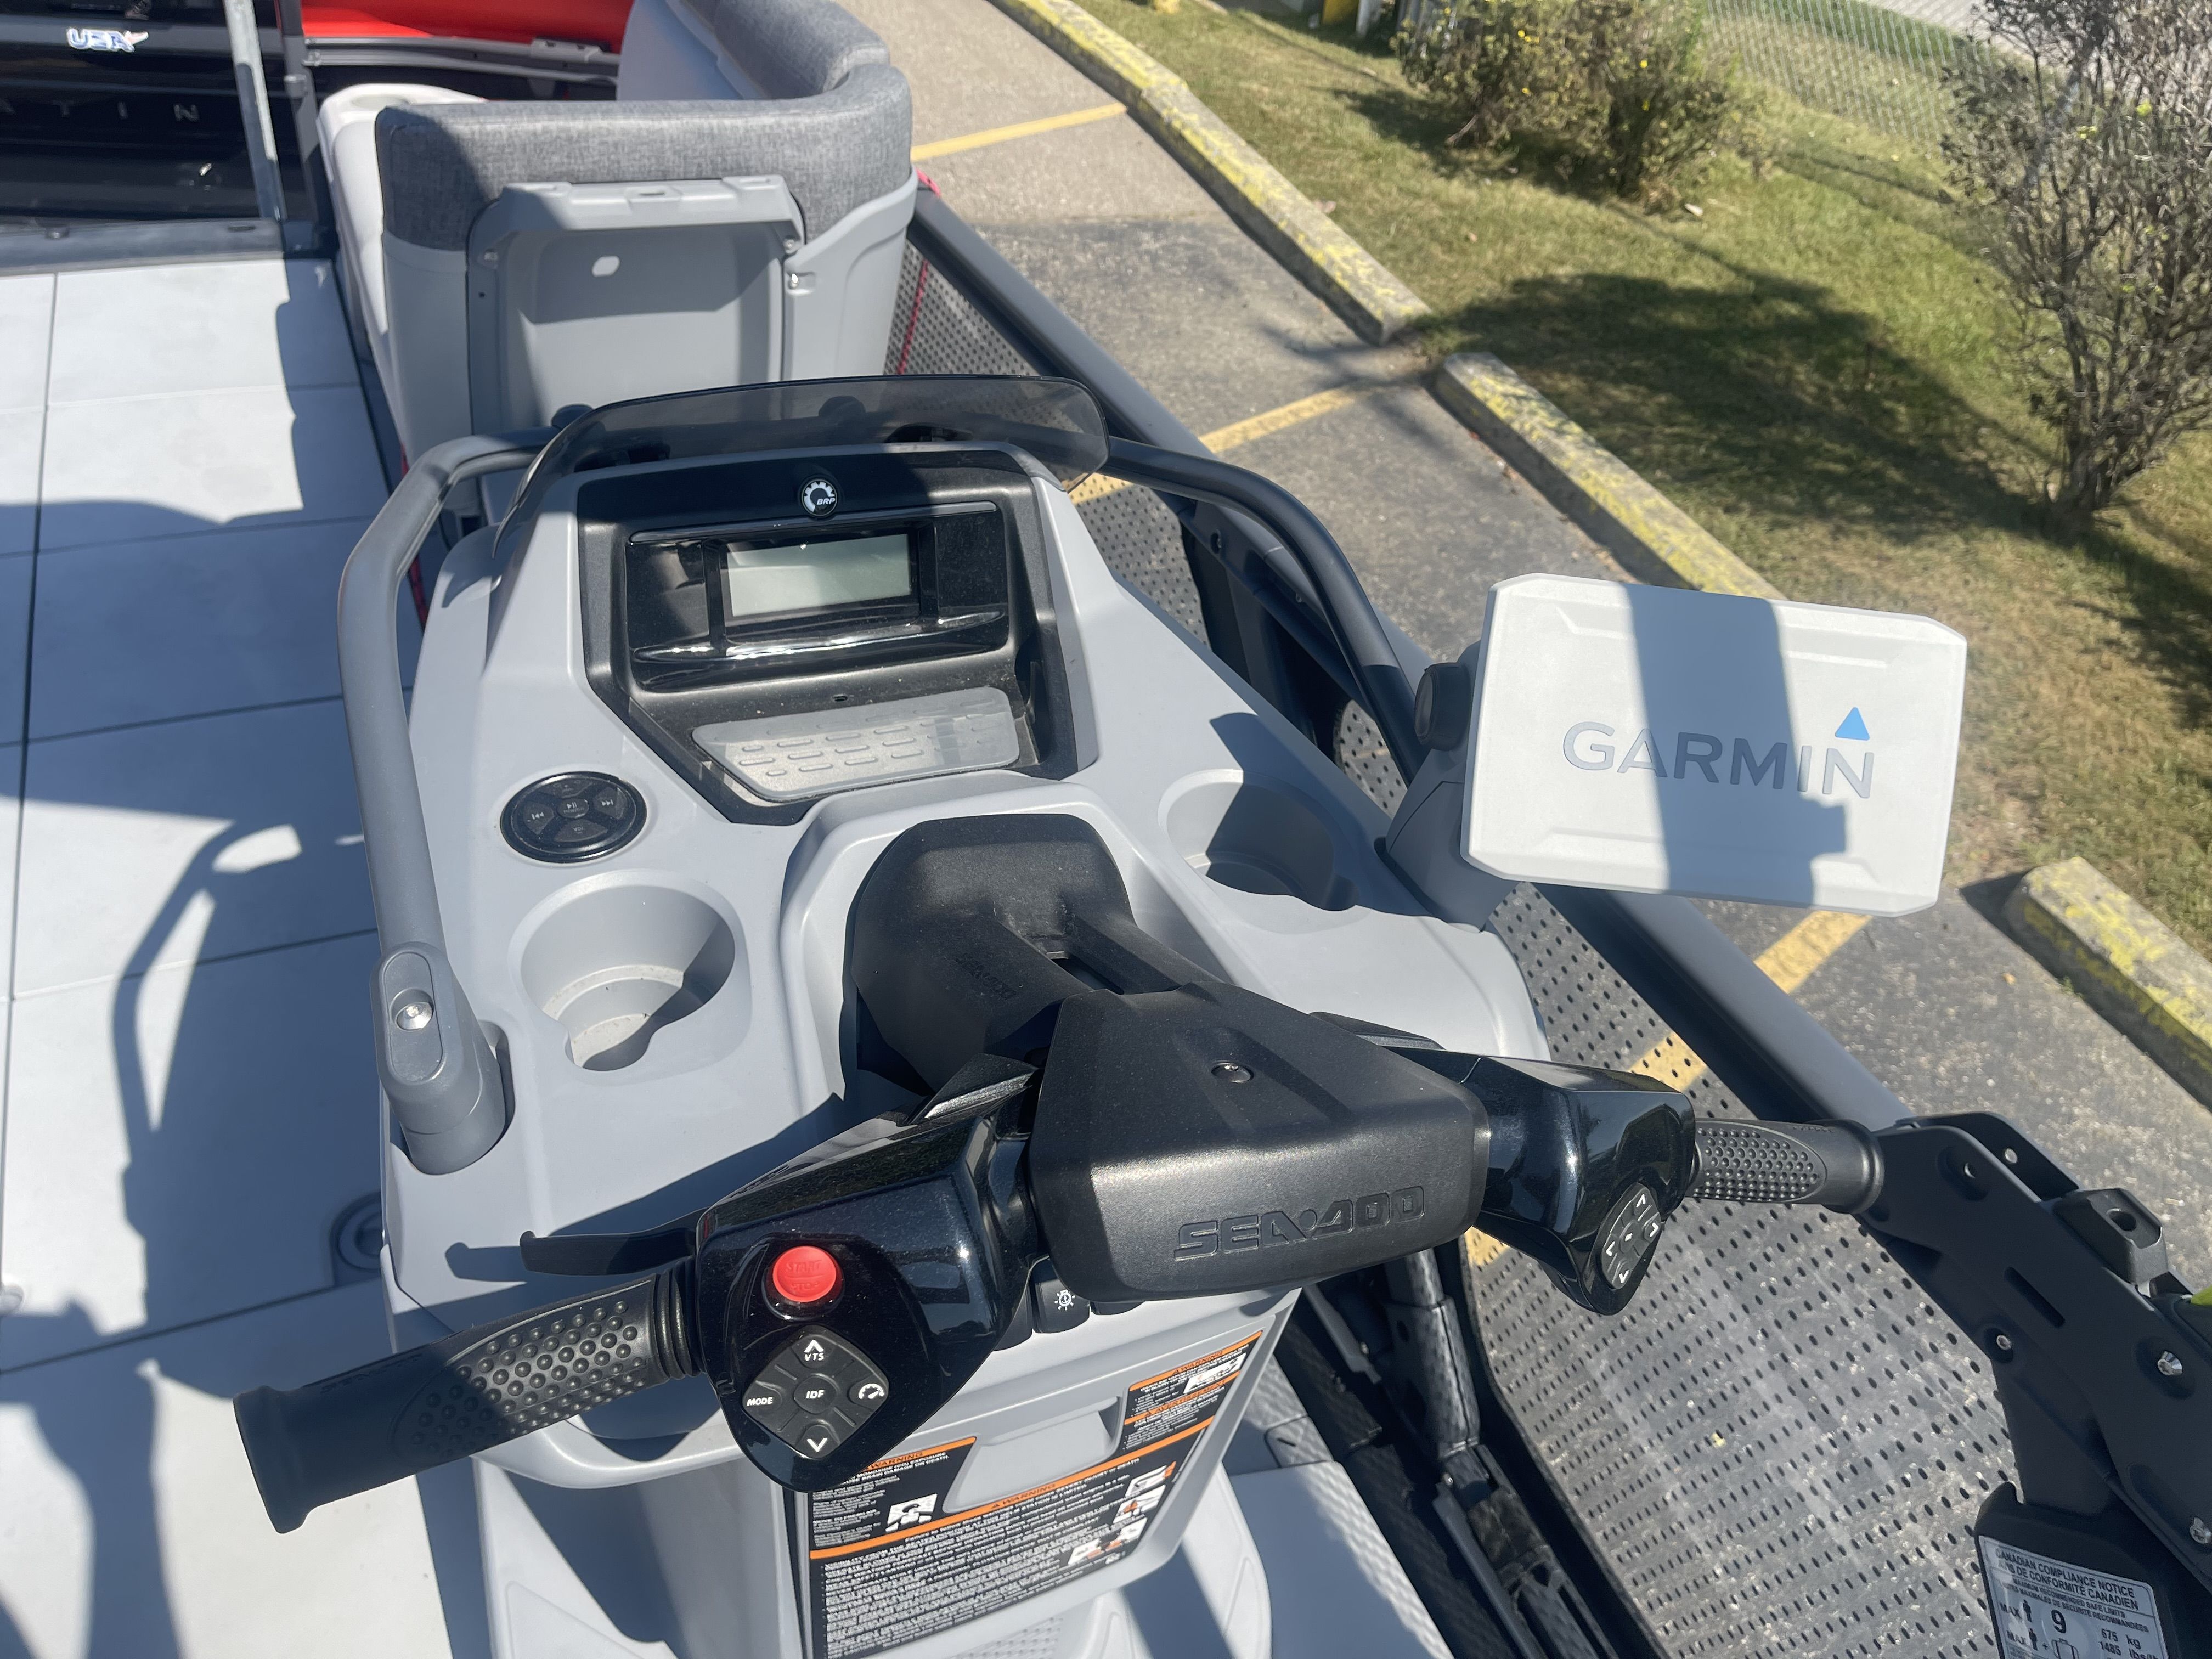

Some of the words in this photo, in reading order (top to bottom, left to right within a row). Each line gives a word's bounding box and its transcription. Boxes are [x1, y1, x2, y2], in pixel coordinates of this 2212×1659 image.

[1563, 721, 1875, 799] GARMIN
[804, 1352, 825, 1361] VTS
[747, 1396, 772, 1406] MODE
[806, 1390, 825, 1400] IDF
[871, 1452, 923, 1469] WARNING
[1002, 1484, 1055, 1505] WARNING
[1995, 1548, 2036, 1571] CANADIAN
[2038, 1564, 2096, 1588] COMPLIANCE
[2098, 1580, 2135, 1598] NOTICE
[2017, 1566, 2028, 1578] DE
[2030, 1571, 2086, 1596] CONFORMITÉ
[2088, 1589, 2138, 1610] CANADIEN
[2000, 1602, 2023, 1620] MAX
[2086, 1601, 2103, 1612] SAFE
[2103, 1607, 2126, 1618] LIMITS
[2051, 1609, 2067, 1633] 9
[2101, 1627, 2119, 1642] 675
[2125, 1634, 2141, 1650] kg
